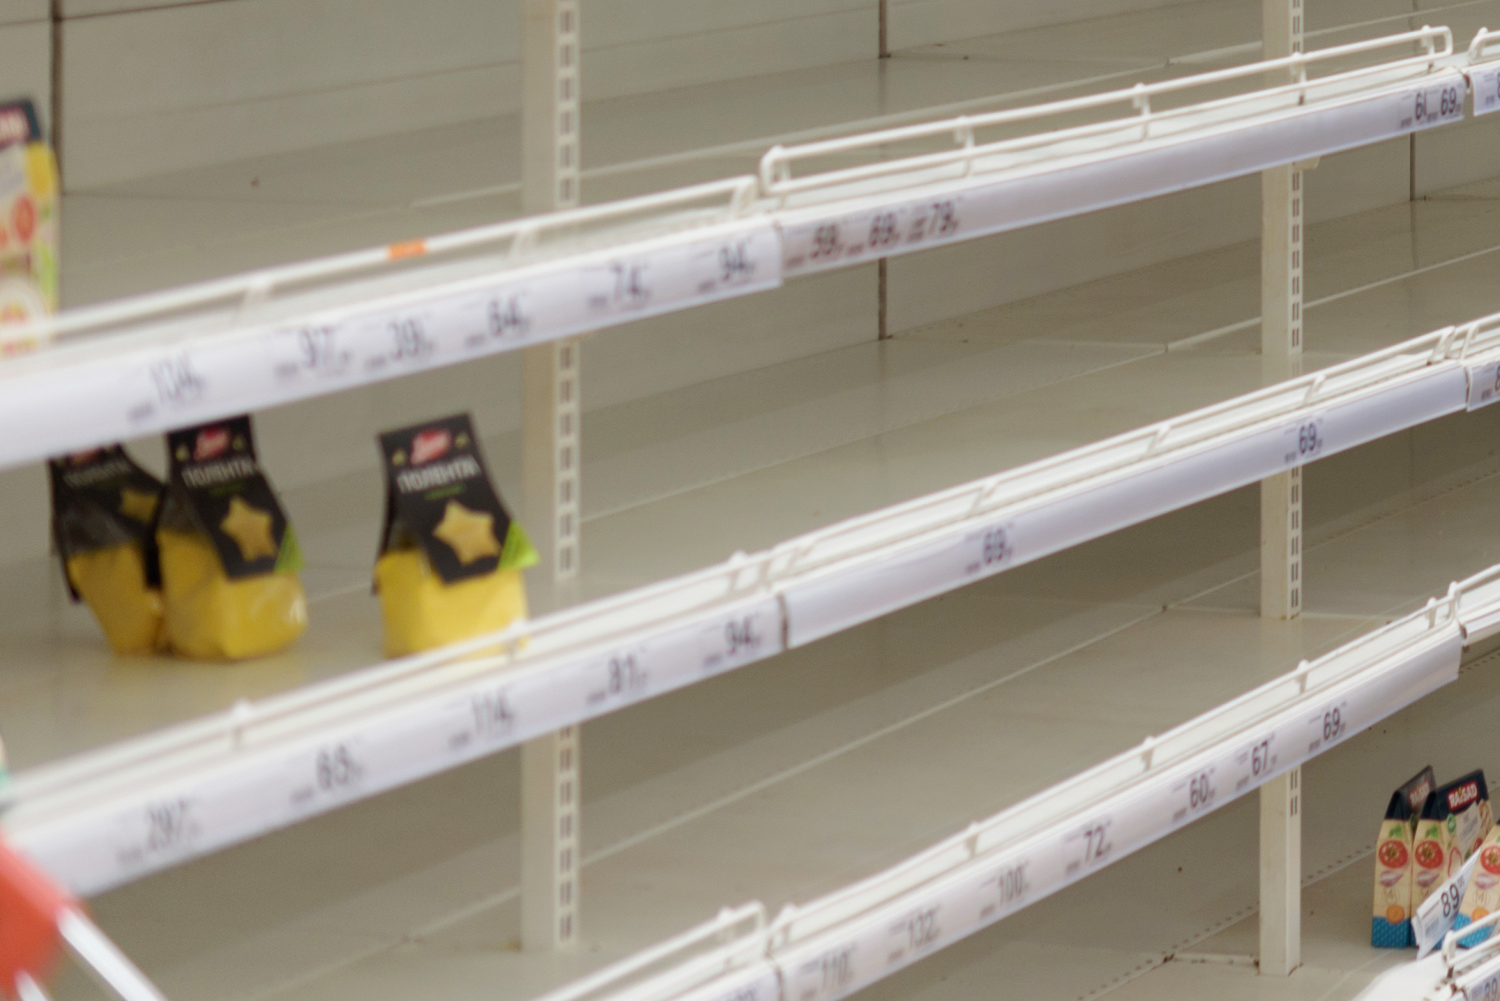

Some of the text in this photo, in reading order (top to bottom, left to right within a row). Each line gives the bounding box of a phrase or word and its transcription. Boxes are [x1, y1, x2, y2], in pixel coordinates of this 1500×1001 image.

[1441, 87, 1457, 116] 69
[1299, 422, 1317, 456] 69
[396, 454, 481, 493] ПОЛЕНТА
[1323, 705, 1341, 742] 69
[1252, 740, 1270, 777] 67
[1189, 773, 1209, 810] 60
[1082, 825, 1107, 864] 72
[1441, 883, 1460, 918] 89
